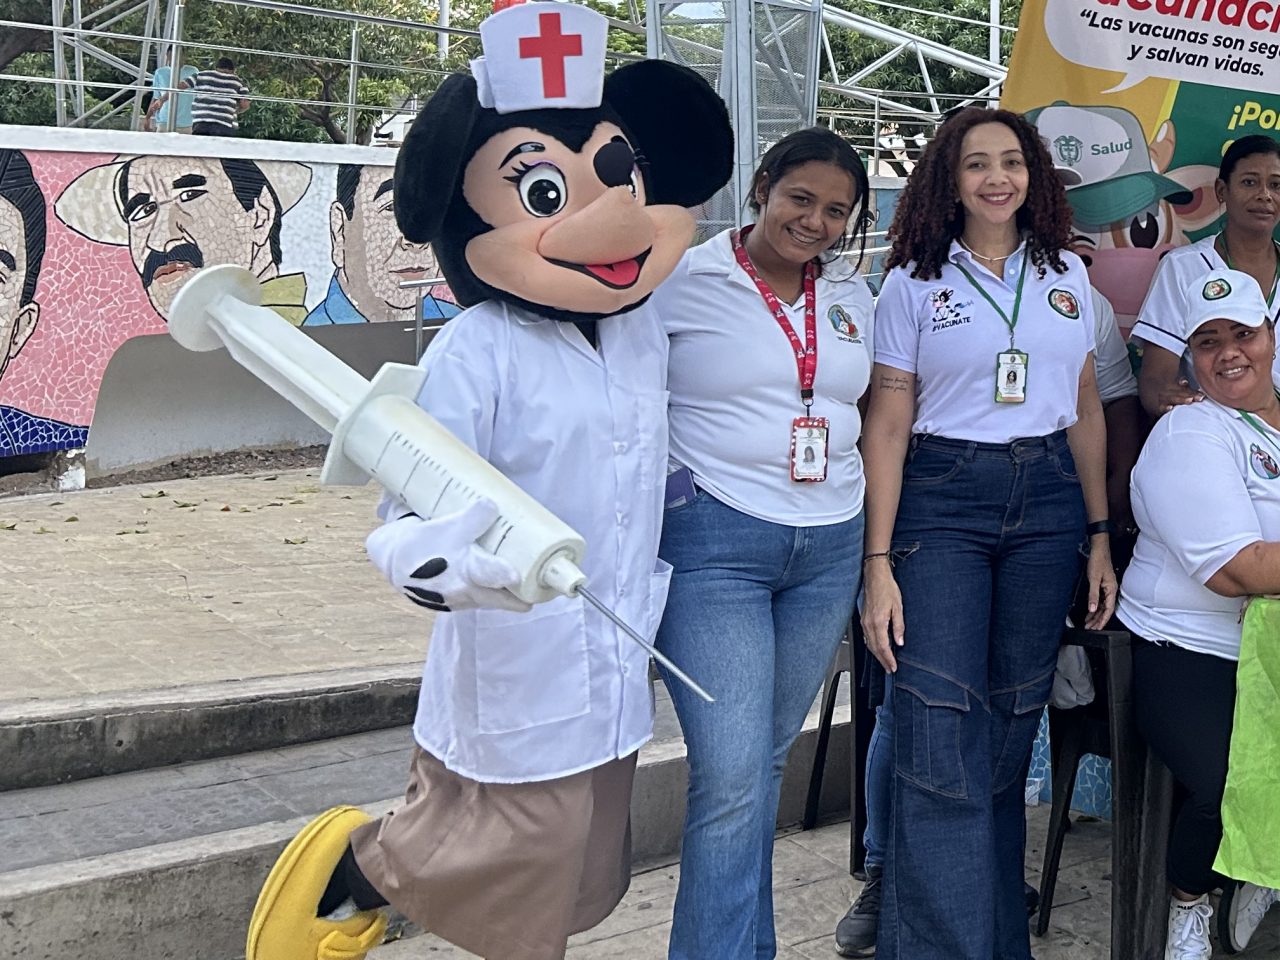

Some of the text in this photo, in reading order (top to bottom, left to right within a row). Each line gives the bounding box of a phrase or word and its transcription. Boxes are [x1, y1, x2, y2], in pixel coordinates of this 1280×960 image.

[1128, 21, 1209, 45] vacunas
[1212, 35, 1245, 50] son
[1127, 44, 1264, 76] y salvan vidas.
[1090, 138, 1133, 155] Salud
